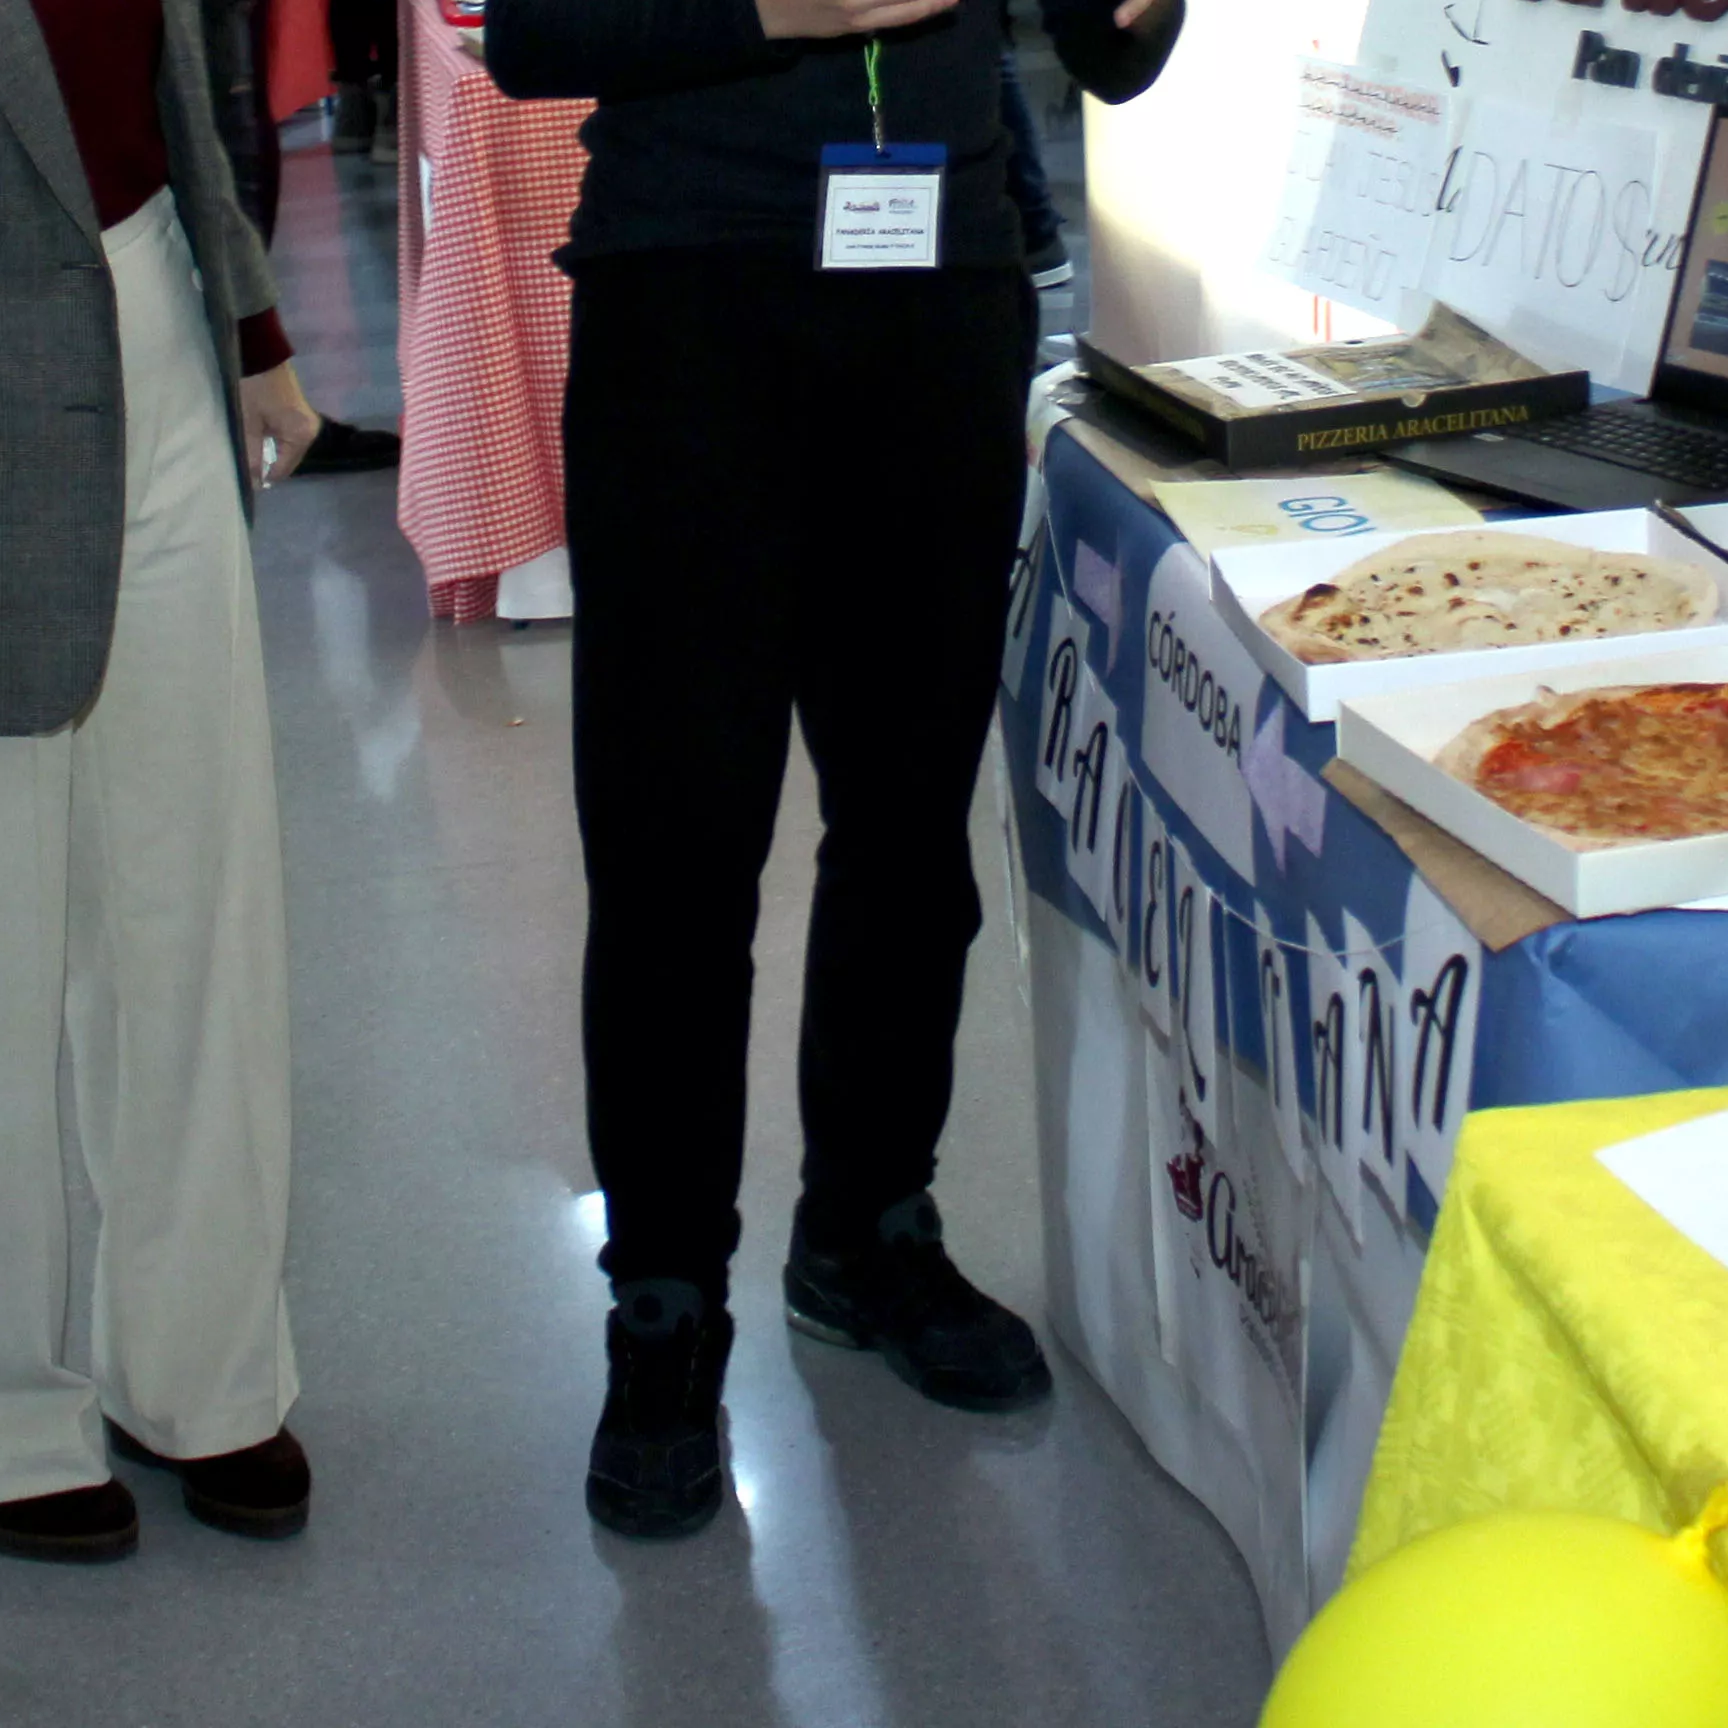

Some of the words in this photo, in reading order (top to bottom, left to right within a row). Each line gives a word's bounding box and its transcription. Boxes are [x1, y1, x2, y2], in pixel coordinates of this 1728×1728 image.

[1296, 423, 1390, 452] PIZZERIA
[1391, 404, 1530, 440] ARACELITANA
[1148, 608, 1244, 773] CÓRDOBA
